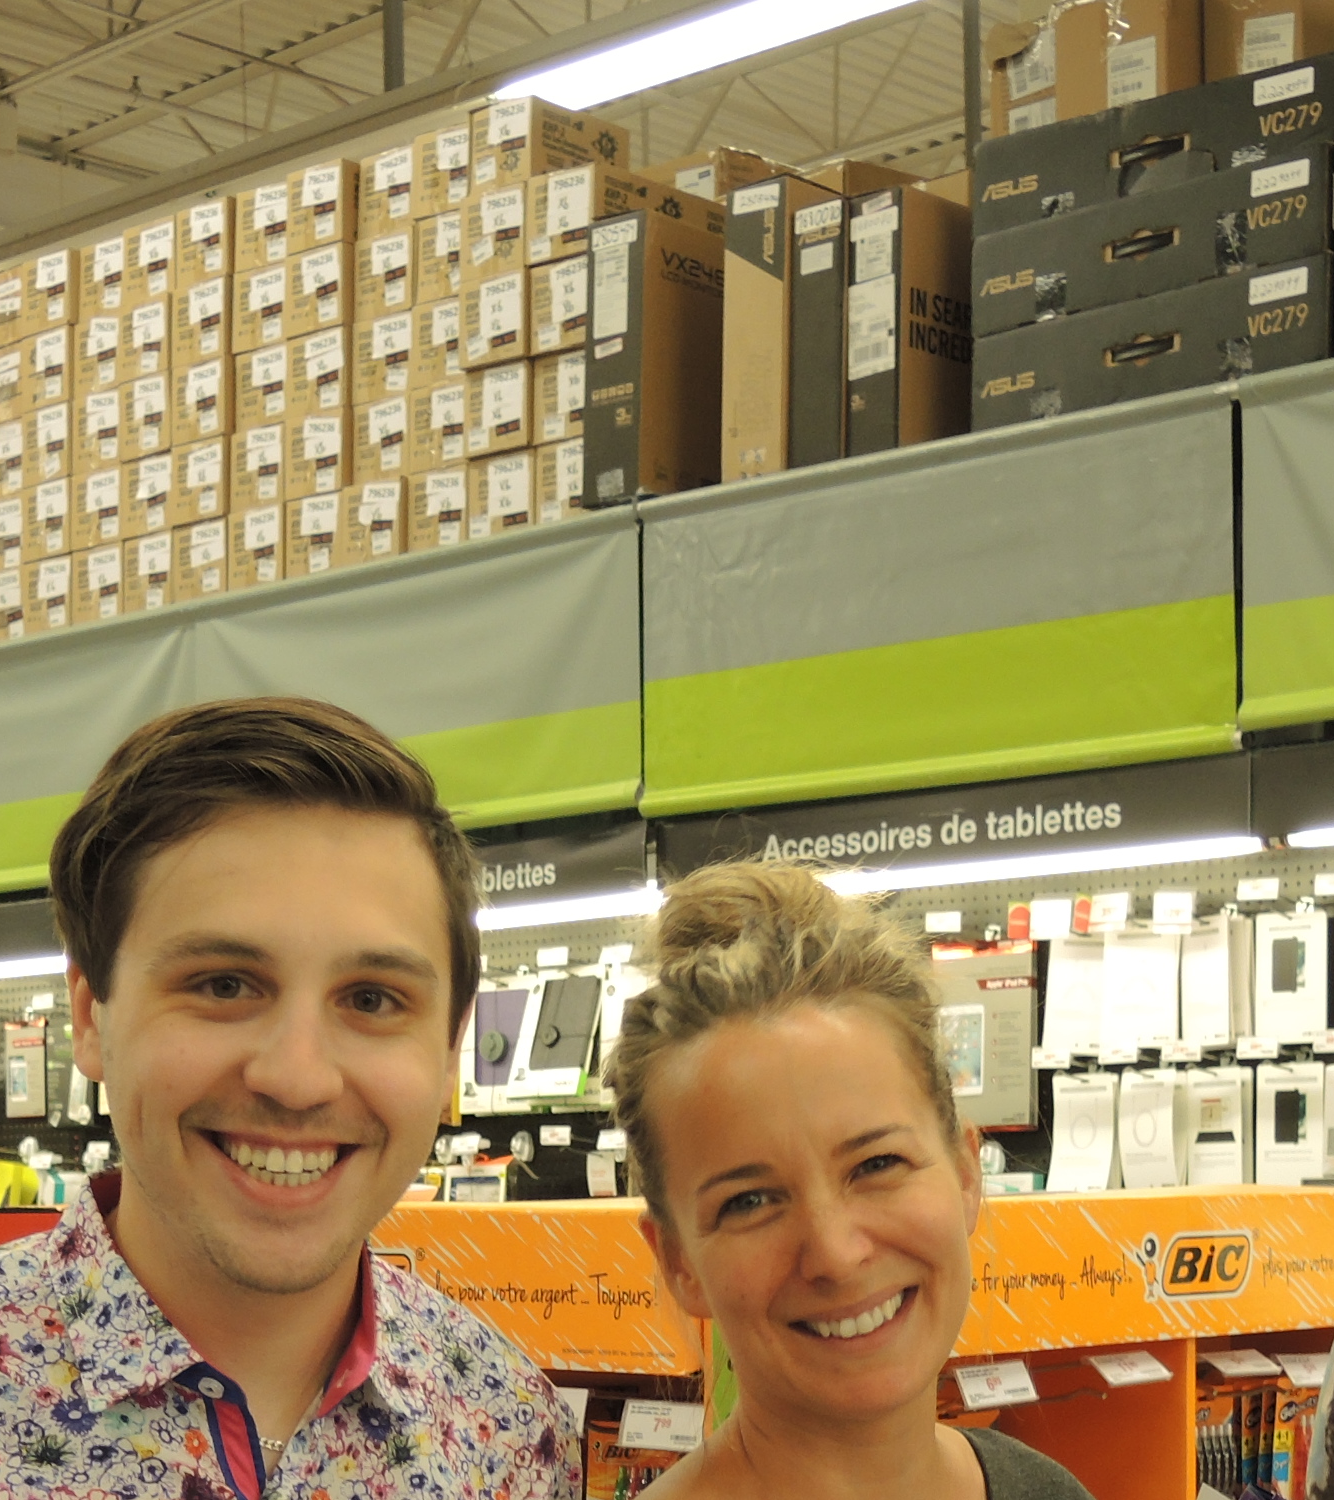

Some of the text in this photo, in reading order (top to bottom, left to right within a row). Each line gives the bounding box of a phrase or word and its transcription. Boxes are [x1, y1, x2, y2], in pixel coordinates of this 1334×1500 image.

[495, 102, 526, 119] 796236
[1258, 101, 1324, 137] VC279
[379, 153, 409, 171] 796236
[306, 170, 336, 187] 796236
[553, 174, 585, 191] 796236
[981, 174, 1039, 203] ASUS
[258, 188, 287, 204] 796236
[486, 194, 518, 210] 796236
[1246, 194, 1309, 231] VC279
[375, 240, 405, 256] 796236
[305, 253, 335, 269] 796236
[255, 273, 284, 290] 796236
[484, 281, 518, 298] 796236
[979, 268, 1035, 298] ASUS
[908, 286, 926, 318] IN
[378, 318, 409, 335] 796236
[1247, 303, 1310, 338] VC279
[981, 371, 1036, 399] ASUS
[762, 802, 1122, 864] Accessoires de tablettes
[1261, 1250, 1284, 1290] plus
[1285, 1256, 1309, 1287] pour
[982, 1262, 999, 1294] for
[1001, 1265, 1031, 1304] your
[1030, 1270, 1067, 1301] money
[457, 1281, 488, 1313] pour
[490, 1278, 527, 1303] votre
[530, 1283, 579, 1320] argent
